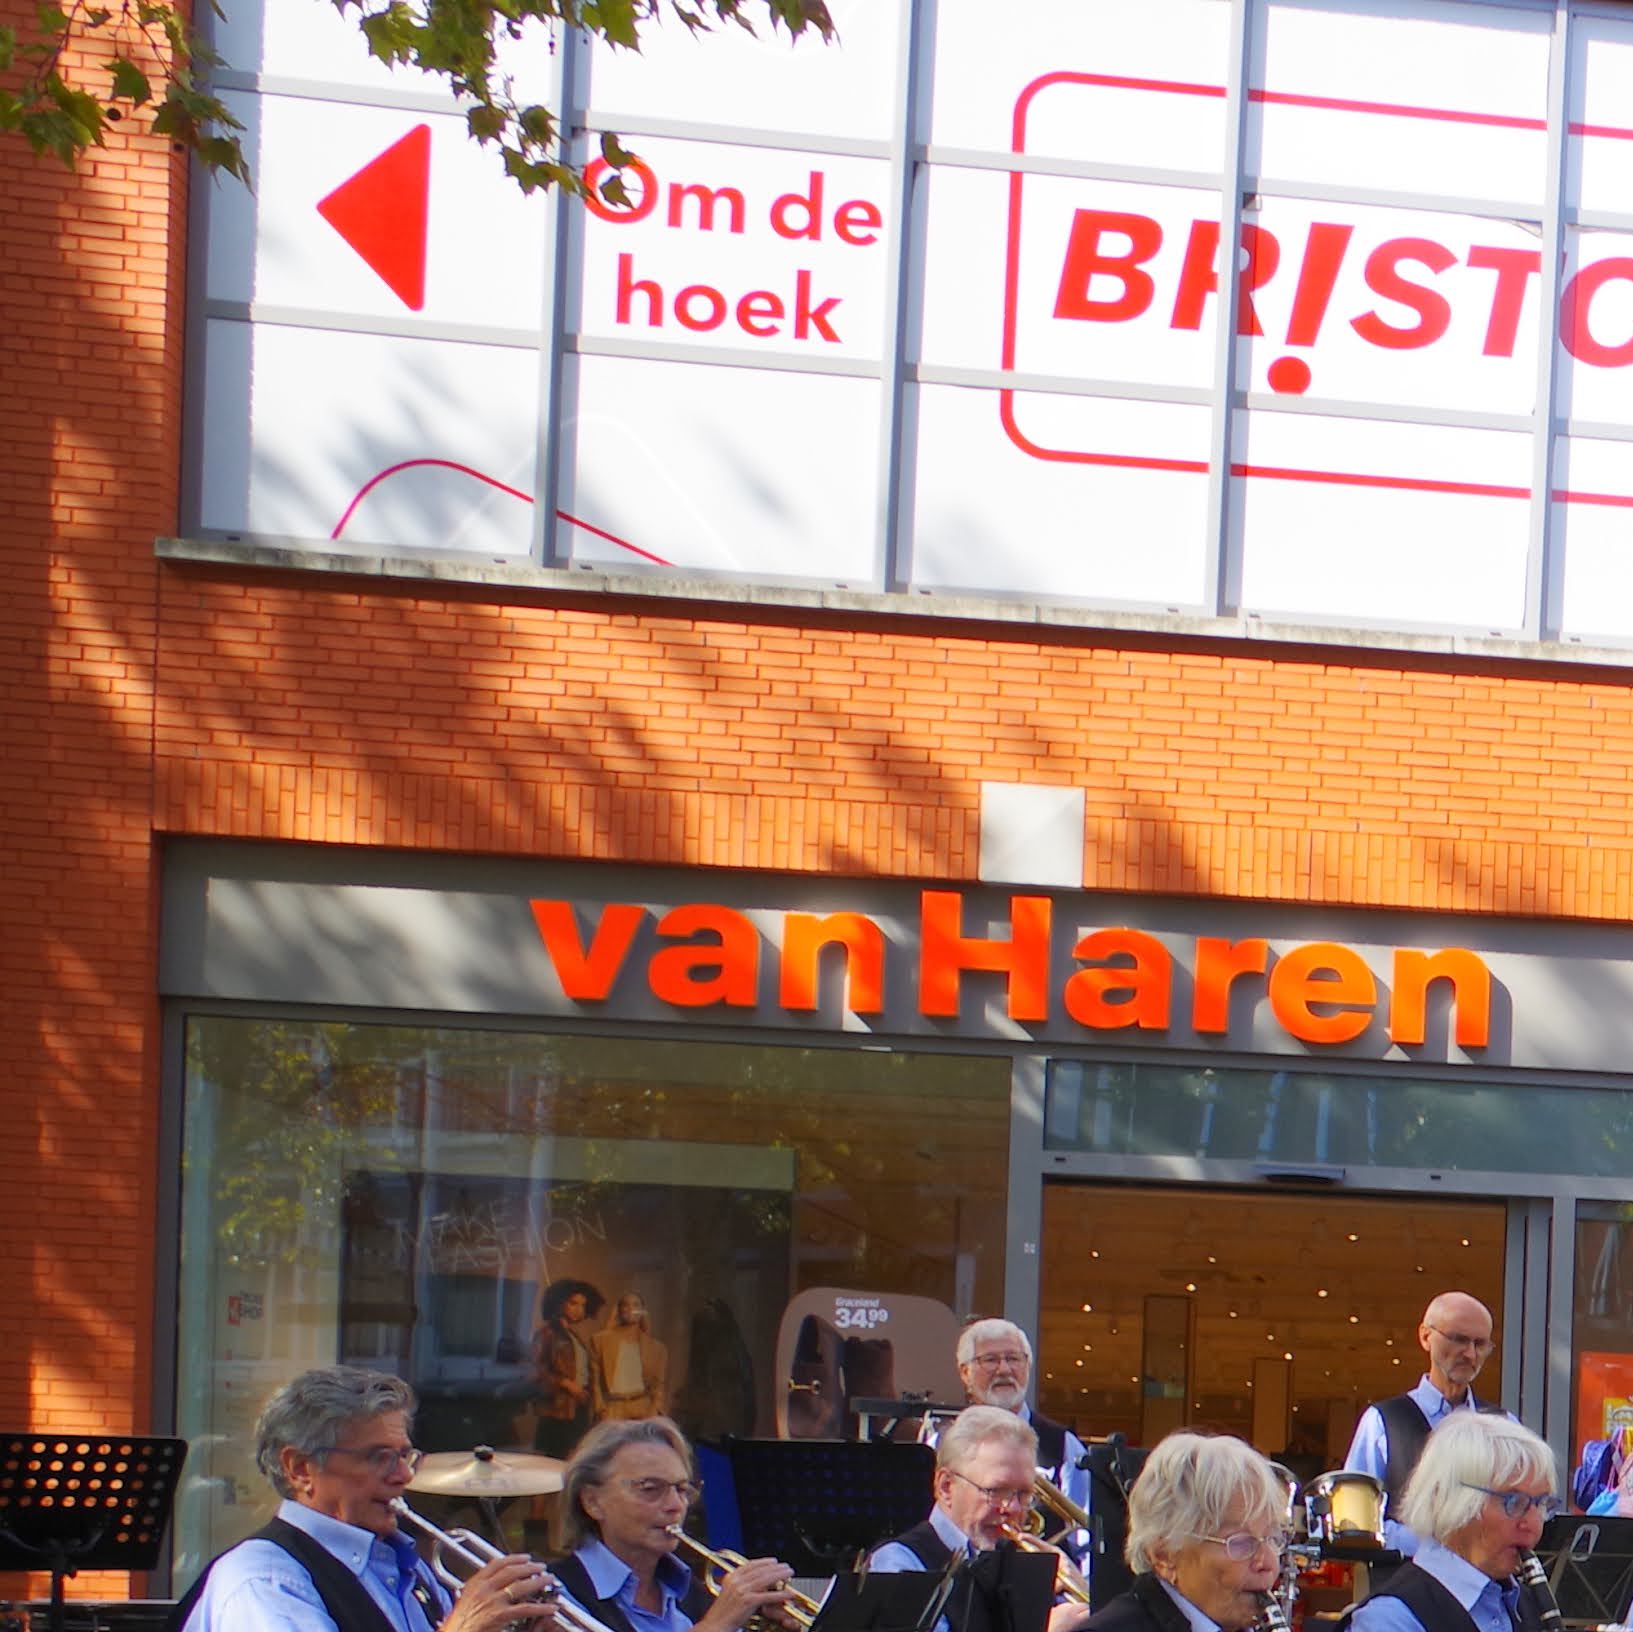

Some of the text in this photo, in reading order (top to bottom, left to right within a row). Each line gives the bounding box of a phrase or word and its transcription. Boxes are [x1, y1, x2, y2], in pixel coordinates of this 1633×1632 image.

[583, 156, 882, 246] Om de
[616, 253, 842, 343] hoek
[834, 1307, 889, 1329] 34.99
